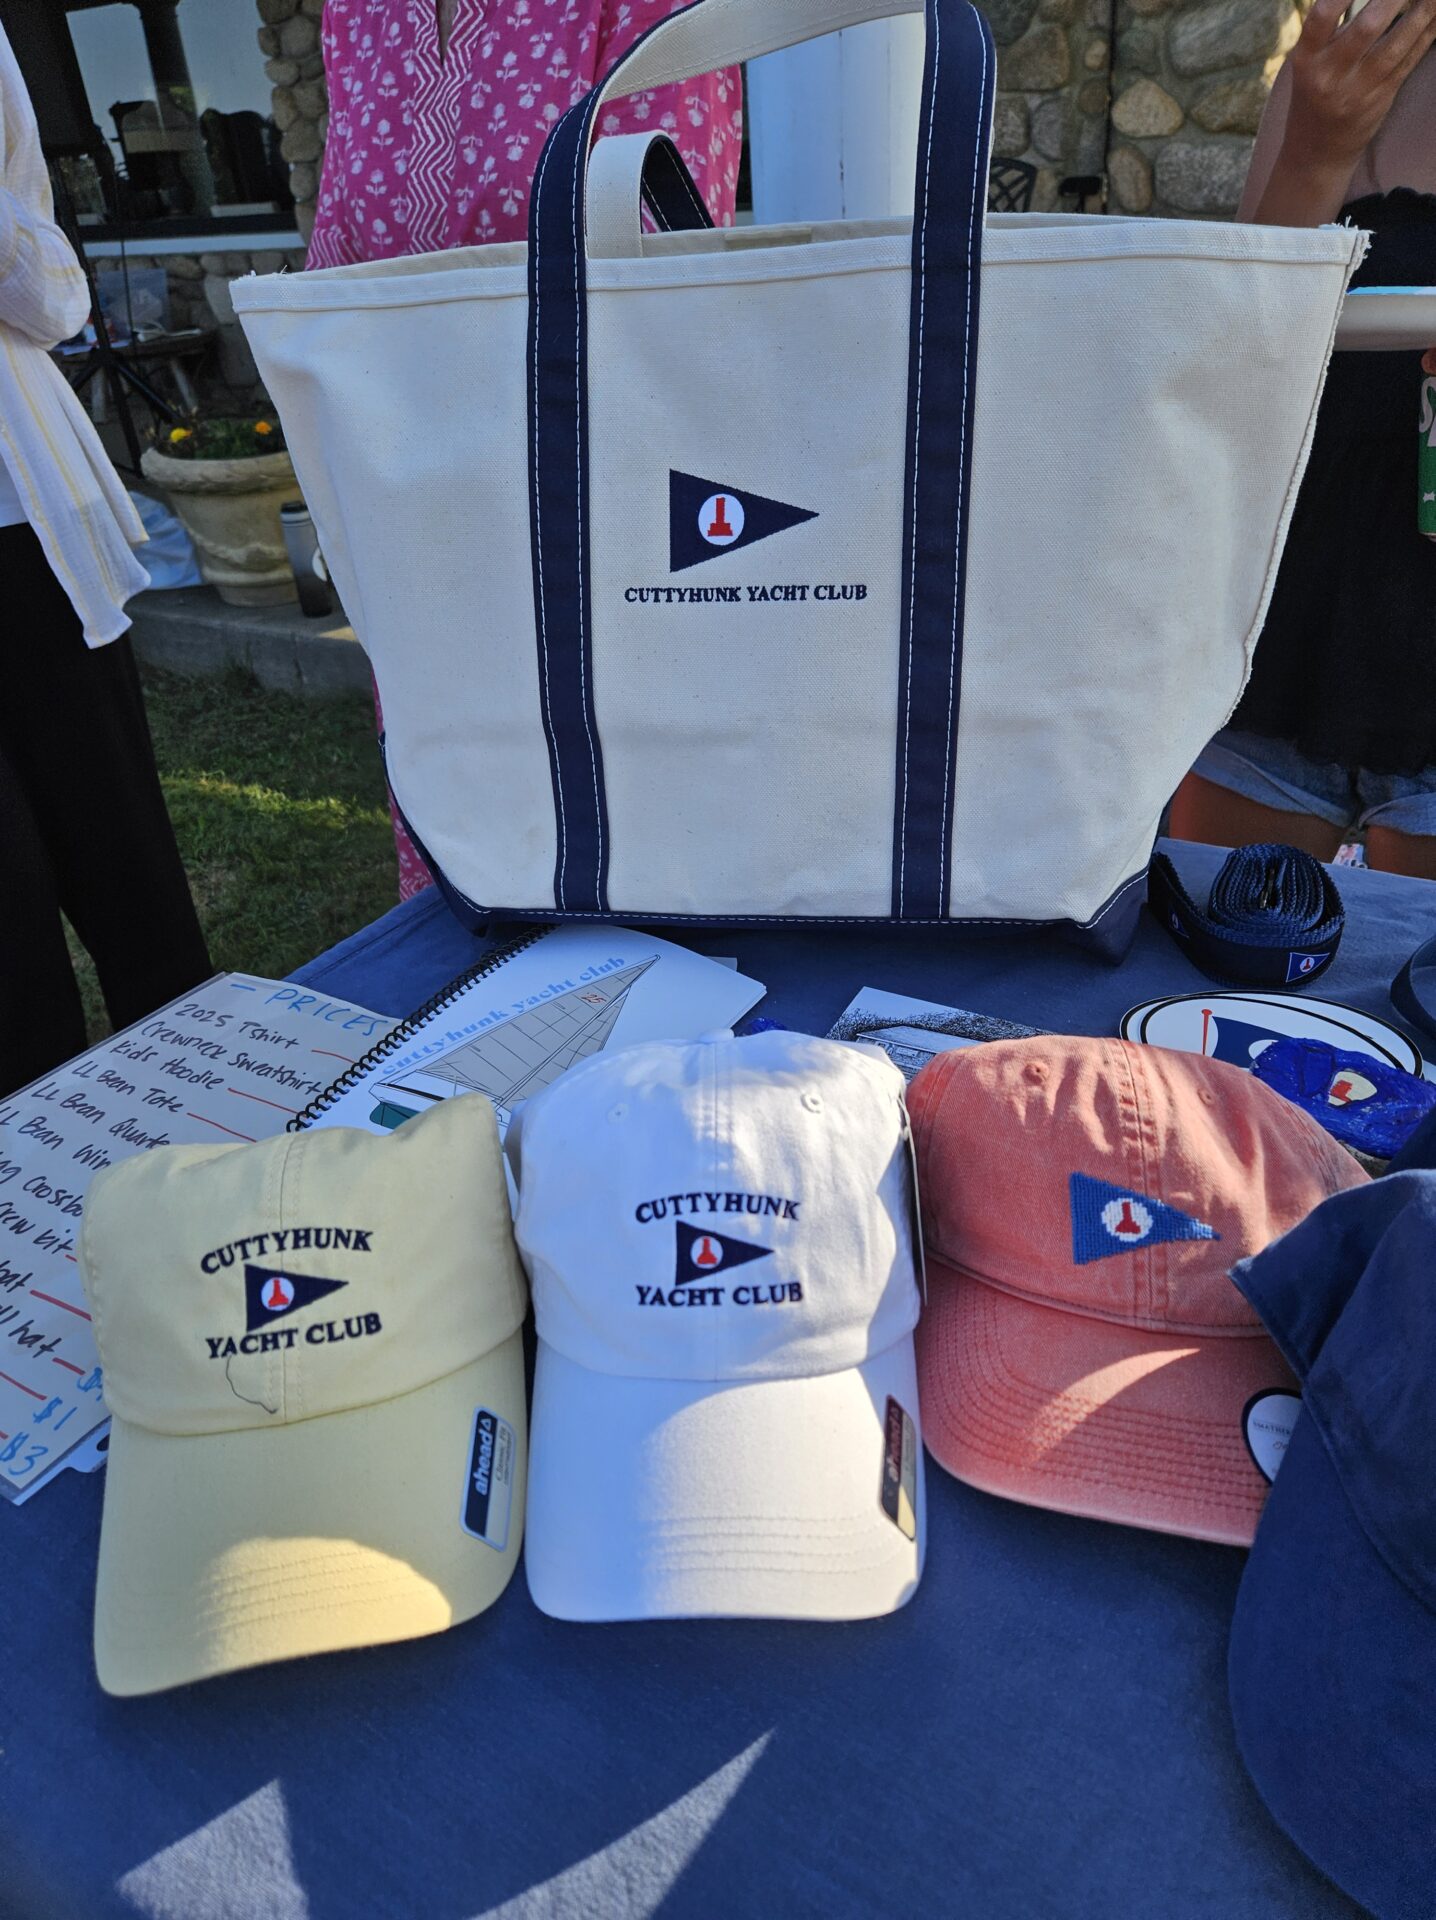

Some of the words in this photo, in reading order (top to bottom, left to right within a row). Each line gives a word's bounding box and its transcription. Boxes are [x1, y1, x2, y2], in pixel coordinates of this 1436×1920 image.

[624, 586, 742, 602] CUTTYHUNK
[746, 585, 809, 602] YACHT
[813, 584, 868, 601] CLUB
[175, 1003, 234, 1028] 2025
[264, 988, 389, 1036] PRICES
[382, 1008, 509, 1076] cuttyhunk
[511, 977, 577, 1013] yacht
[579, 956, 626, 982] club
[109, 1040, 159, 1062] Kids
[159, 1057, 225, 1090] Hoodie
[141, 1021, 228, 1060] Crewneck
[227, 1051, 324, 1096] Sweatshirt
[31, 1081, 60, 1101] LL
[59, 1092, 106, 1125] Bean
[71, 1060, 99, 1079] LL
[96, 1069, 136, 1096] Bean
[141, 1087, 184, 1113] Tote
[17, 1115, 65, 1151] Bean
[635, 1191, 801, 1225] CUTTYHUNK
[200, 1227, 374, 1275] CUTTYHUNK
[636, 1285, 725, 1308] YACHT
[732, 1282, 804, 1306] CLUB
[8, 1319, 62, 1358] hat
[205, 1327, 299, 1360] YACHT
[304, 1312, 383, 1345] CLUB
[473, 1428, 494, 1497] ahead
